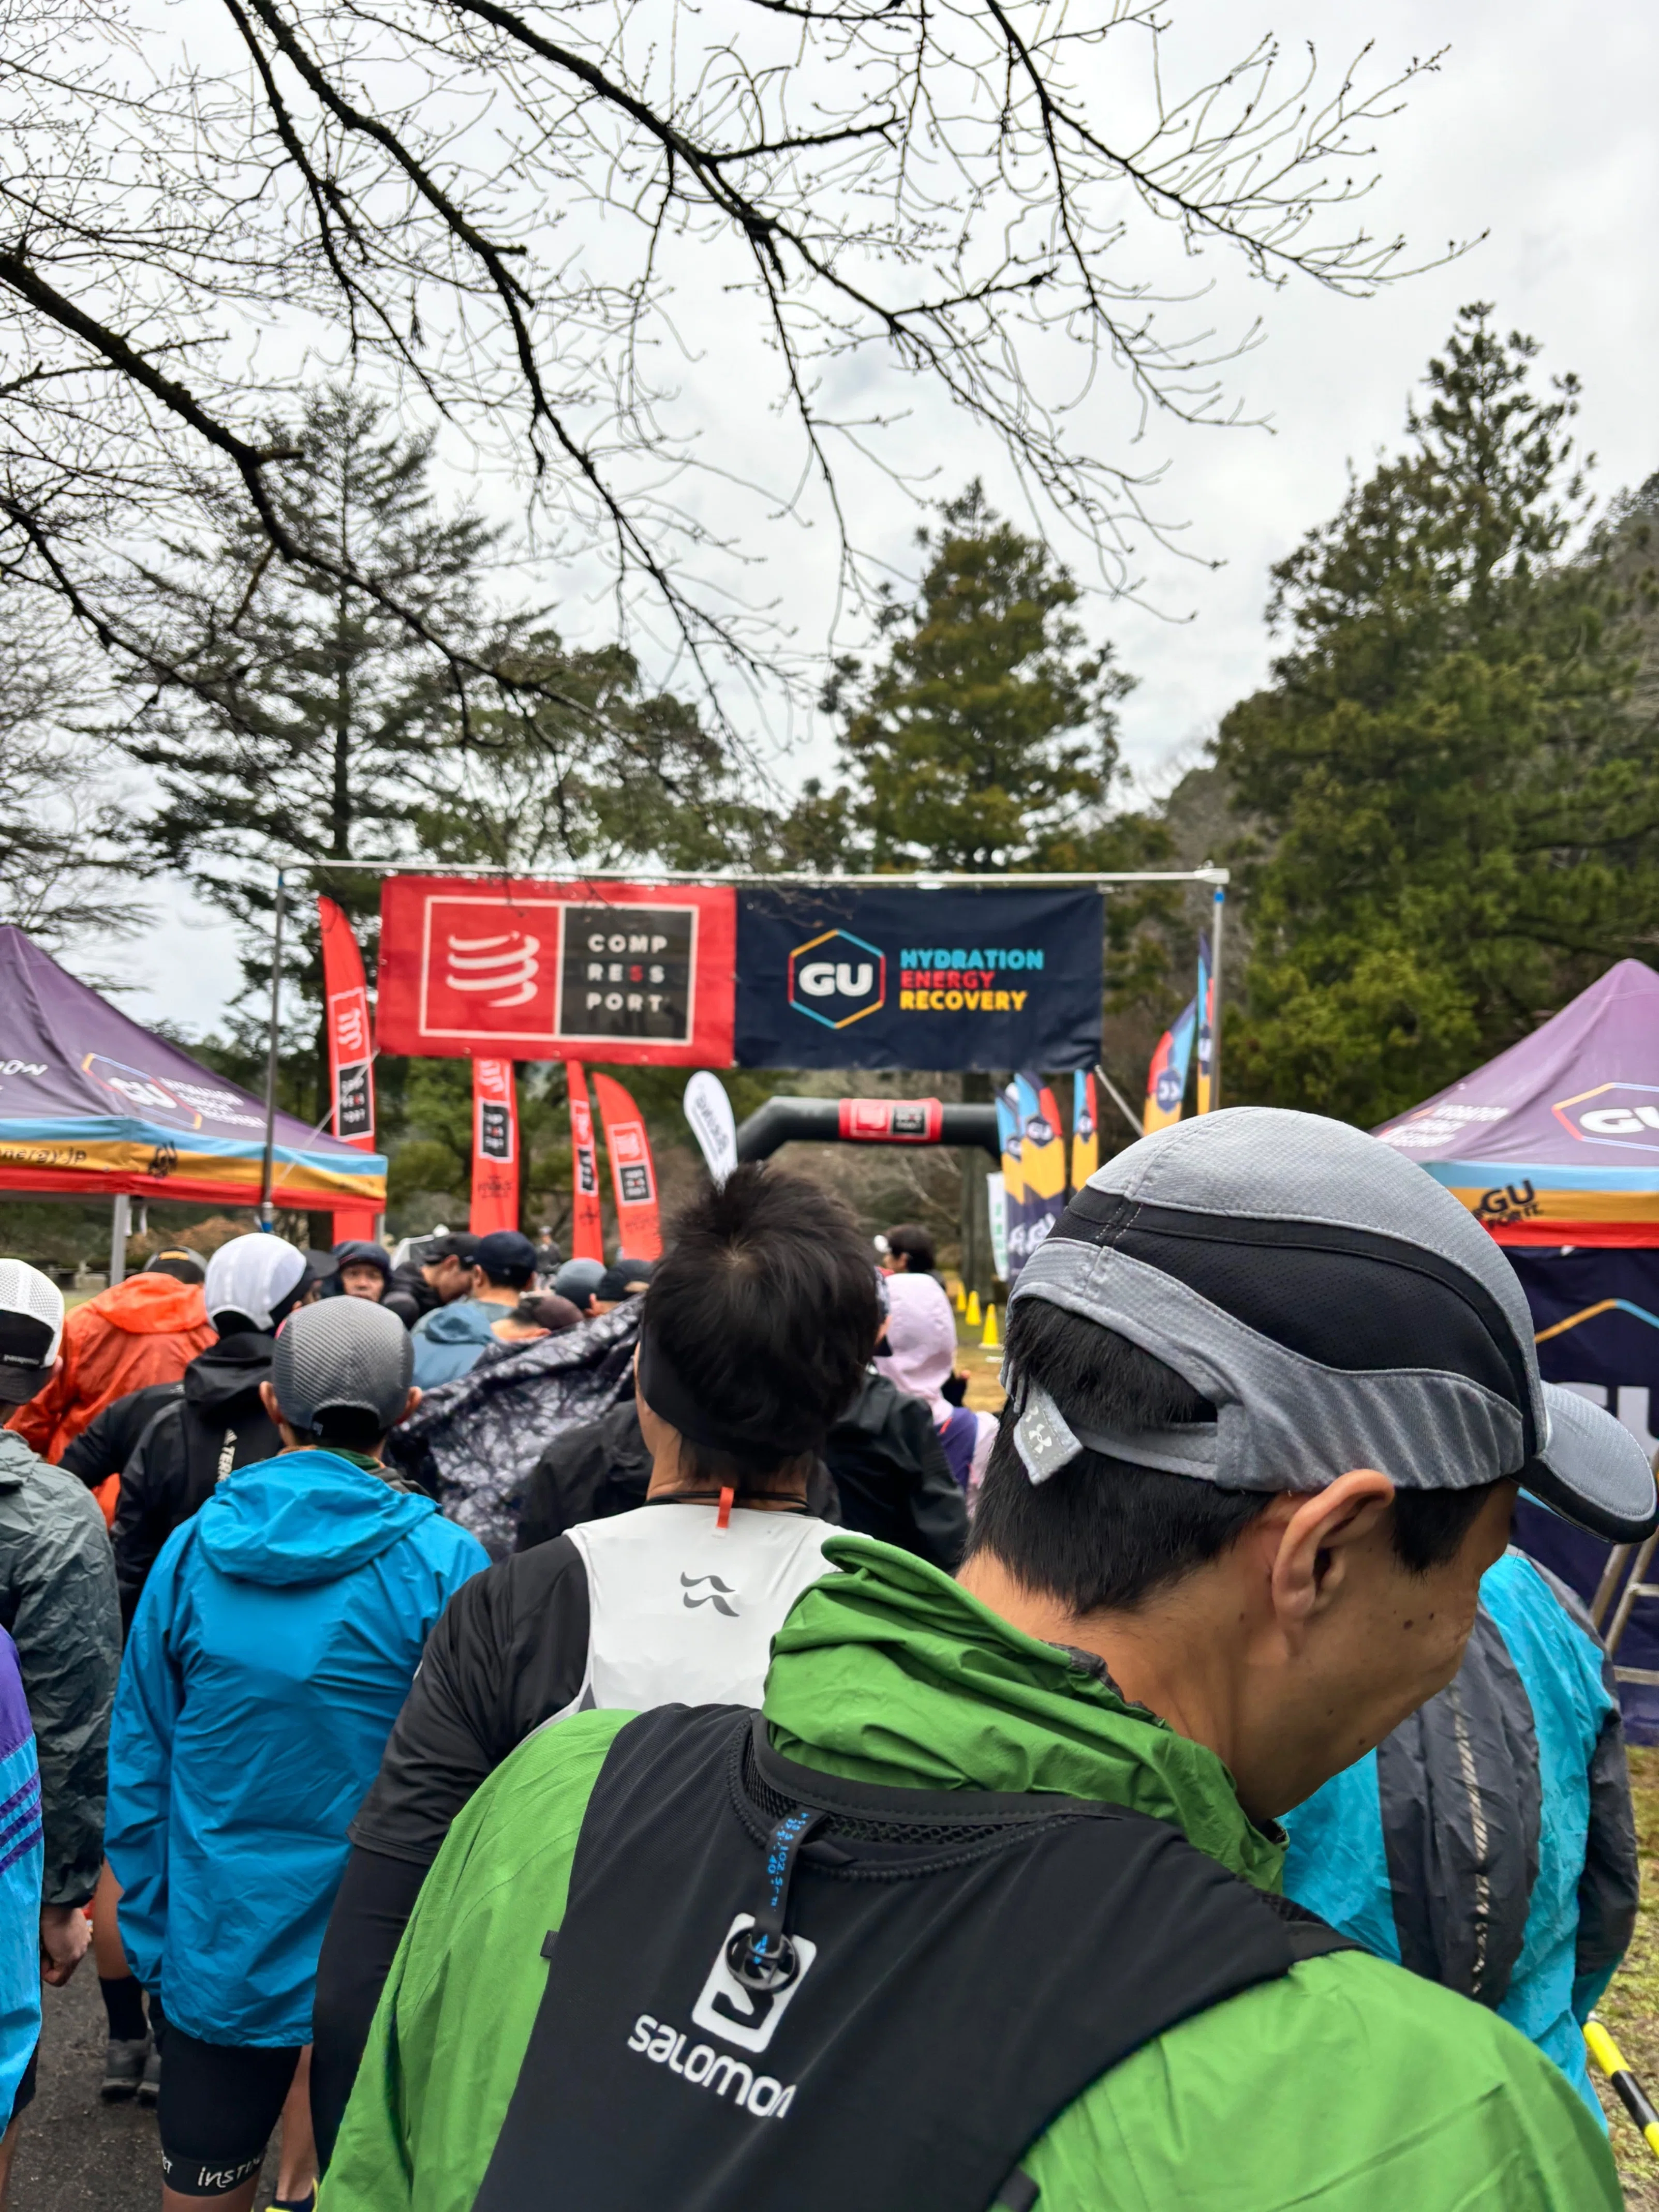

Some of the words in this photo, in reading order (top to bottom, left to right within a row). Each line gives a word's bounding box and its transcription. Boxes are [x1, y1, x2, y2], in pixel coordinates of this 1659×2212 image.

[588, 933, 668, 954] COMP
[900, 948, 1044, 970] HYDRATION
[588, 962, 665, 984] RESS
[798, 962, 873, 997] GU
[900, 969, 995, 989] ENERGY
[586, 988, 663, 1013] PORT
[899, 989, 1028, 1012] RECOVERY
[1481, 1179, 1534, 1213] GU
